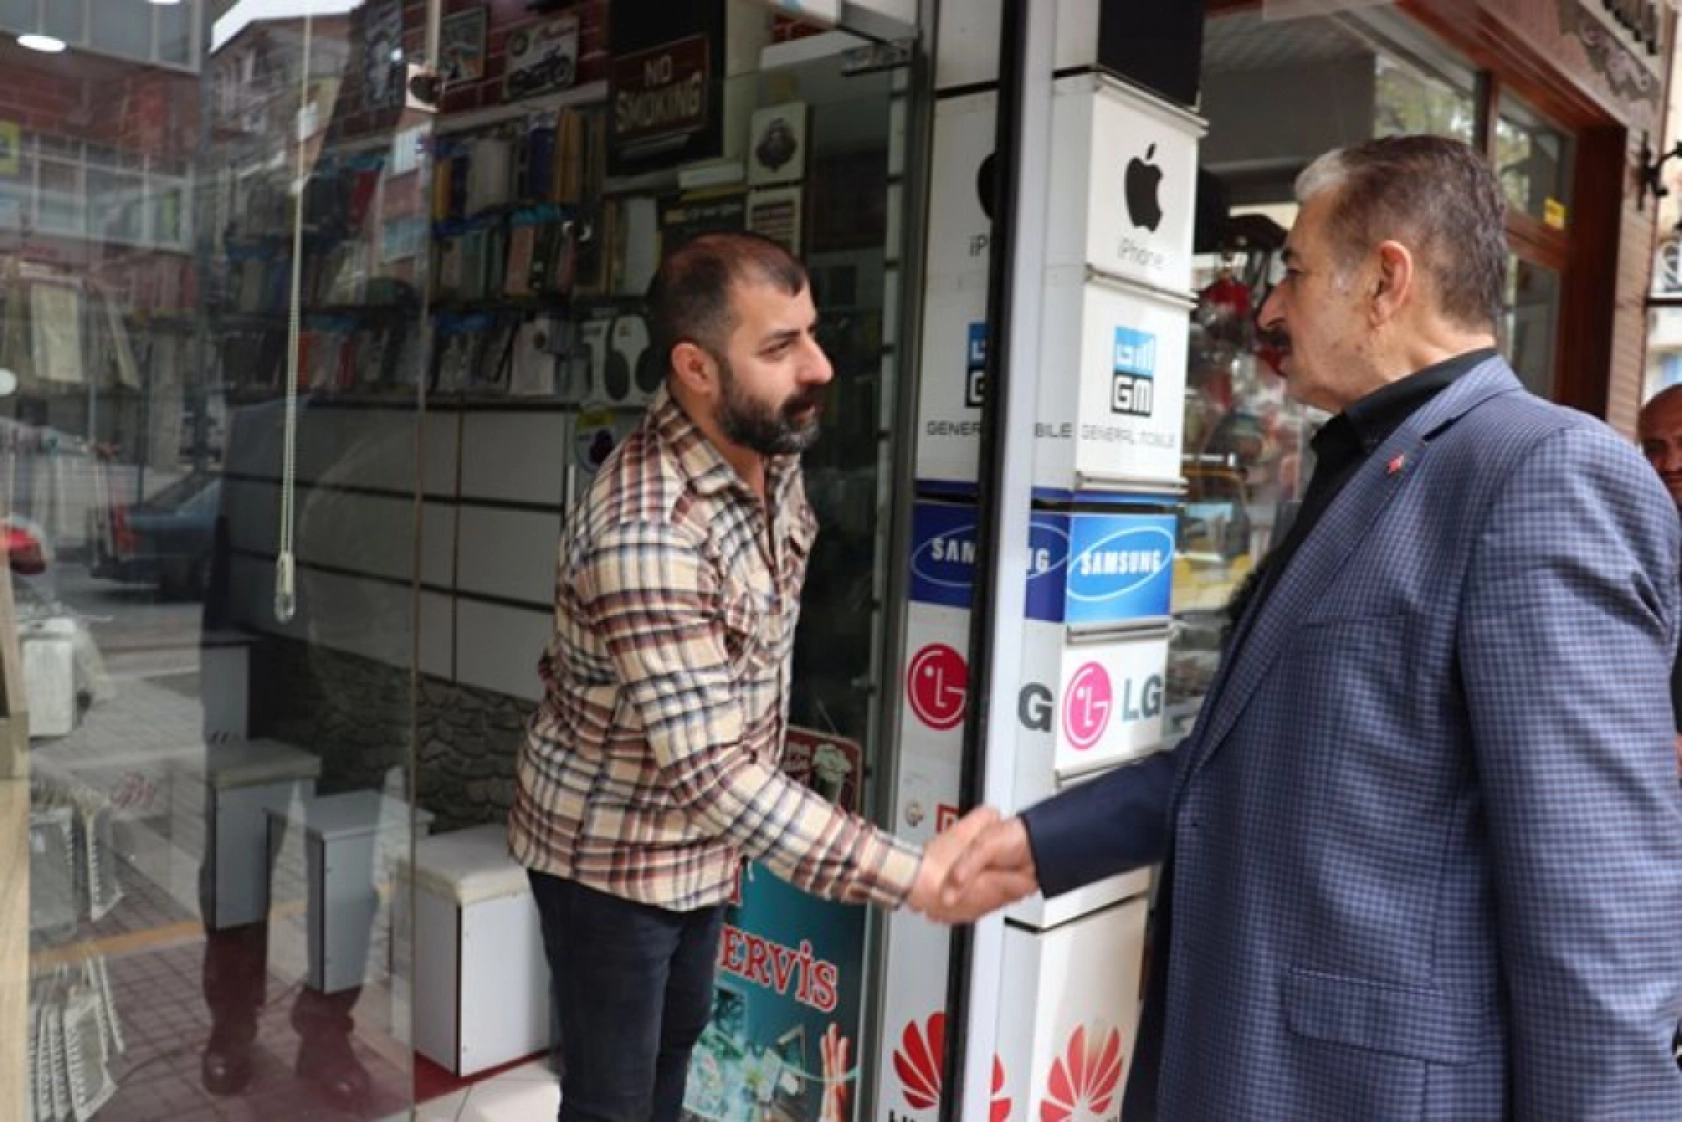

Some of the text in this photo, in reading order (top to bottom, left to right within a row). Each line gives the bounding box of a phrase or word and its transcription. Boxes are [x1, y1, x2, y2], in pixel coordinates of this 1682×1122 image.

[644, 55, 672, 86] NO
[616, 70, 703, 134] SMOKING
[1118, 238, 1165, 270] iPhone
[1080, 550, 1161, 576] SAMSUNG
[1121, 675, 1164, 722] LG
